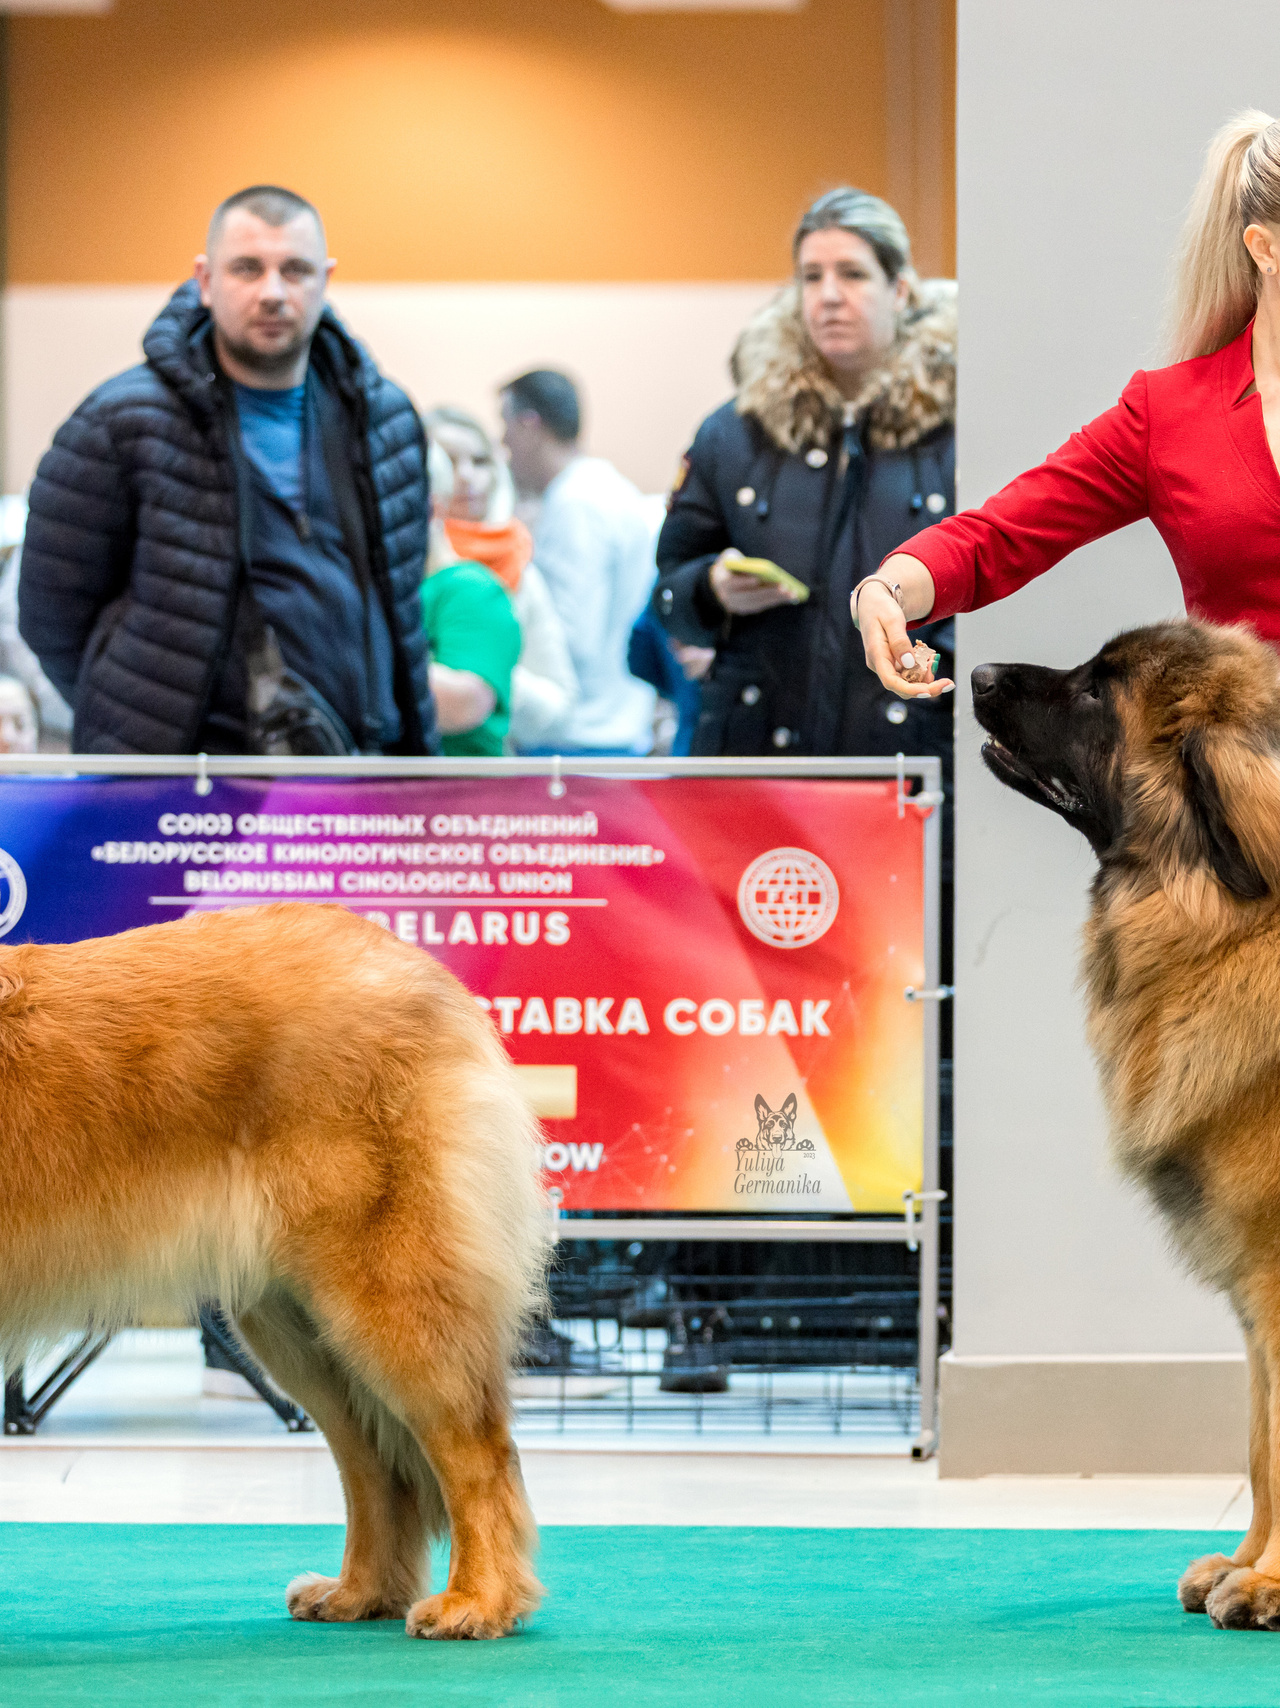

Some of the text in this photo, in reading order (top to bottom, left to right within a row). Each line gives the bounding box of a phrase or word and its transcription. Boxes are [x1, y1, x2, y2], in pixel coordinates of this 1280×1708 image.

[158, 811, 598, 839] СОЮЗ ОБЩЕСТВЕННЫХ ОБЪЕДИНЕНИЙ
[91, 841, 666, 868] «БЕЛОРУССКОЕ КИНОЛОГИЧЕСКОЕ ОБЪЕДИНЕНИЕ»
[184, 870, 573, 893] BELORUSSIAN CINOLOGICAL UNION
[475, 996, 831, 1036] ТАВКА СОБАК
[538, 1142, 604, 1172] OW
